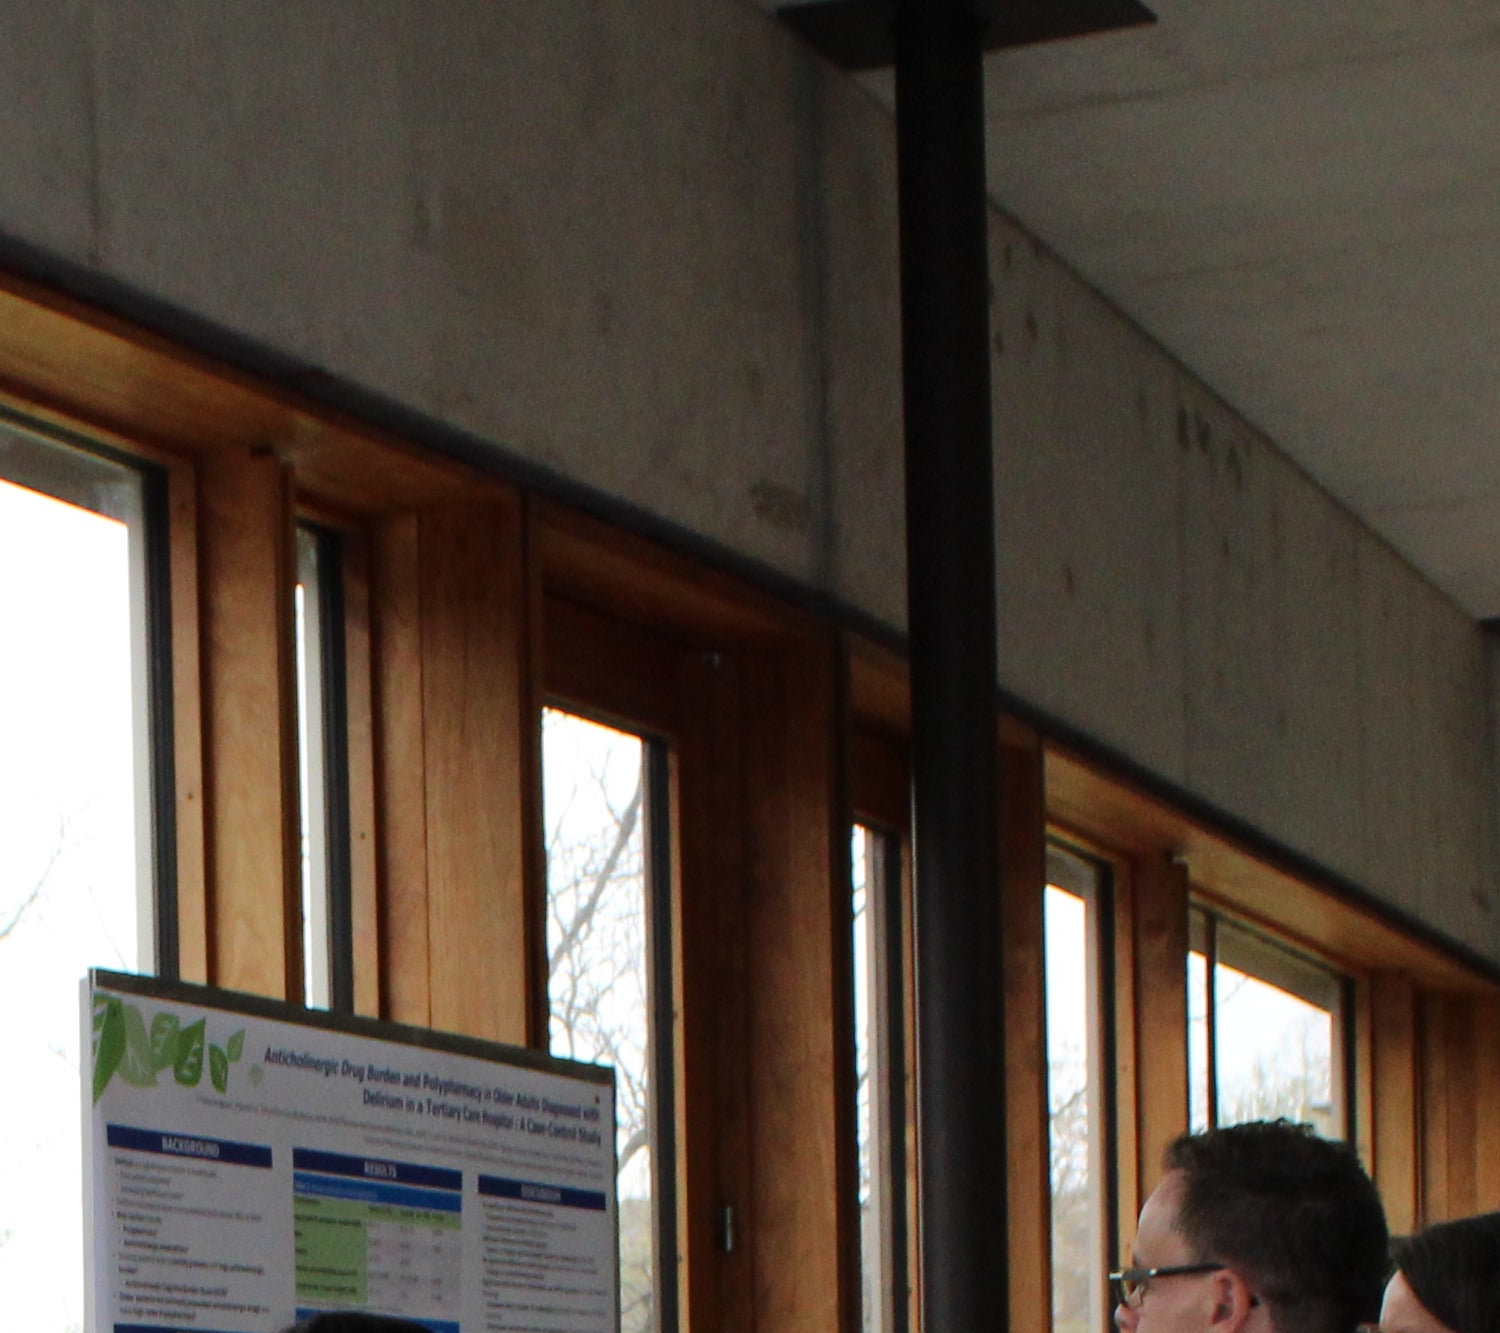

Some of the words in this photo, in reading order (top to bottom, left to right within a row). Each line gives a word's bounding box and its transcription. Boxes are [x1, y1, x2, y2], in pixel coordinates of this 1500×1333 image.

[341, 1059, 365, 1084] Drug
[366, 1063, 400, 1086] Burden
[402, 1071, 420, 1089] and
[161, 1134, 219, 1158] BACKGROUND
[363, 1160, 396, 1179] RESULTS
